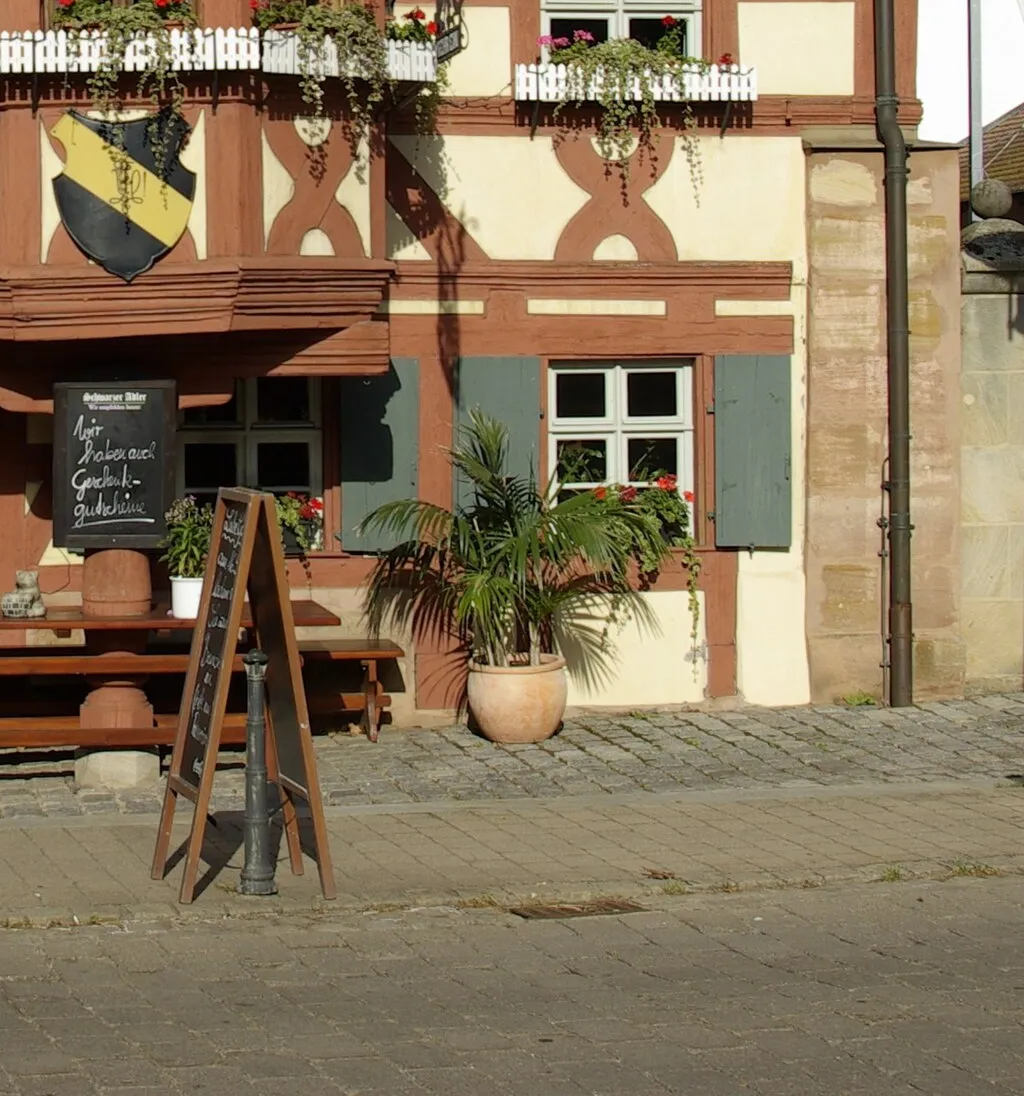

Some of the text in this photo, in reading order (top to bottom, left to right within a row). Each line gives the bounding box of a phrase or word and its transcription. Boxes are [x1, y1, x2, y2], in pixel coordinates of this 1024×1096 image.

[83, 392, 147, 403] Schwarzer Adler
[77, 439, 156, 464] haben auch
[71, 464, 141, 501] Geschenk-
[74, 490, 146, 527] gutscheine
